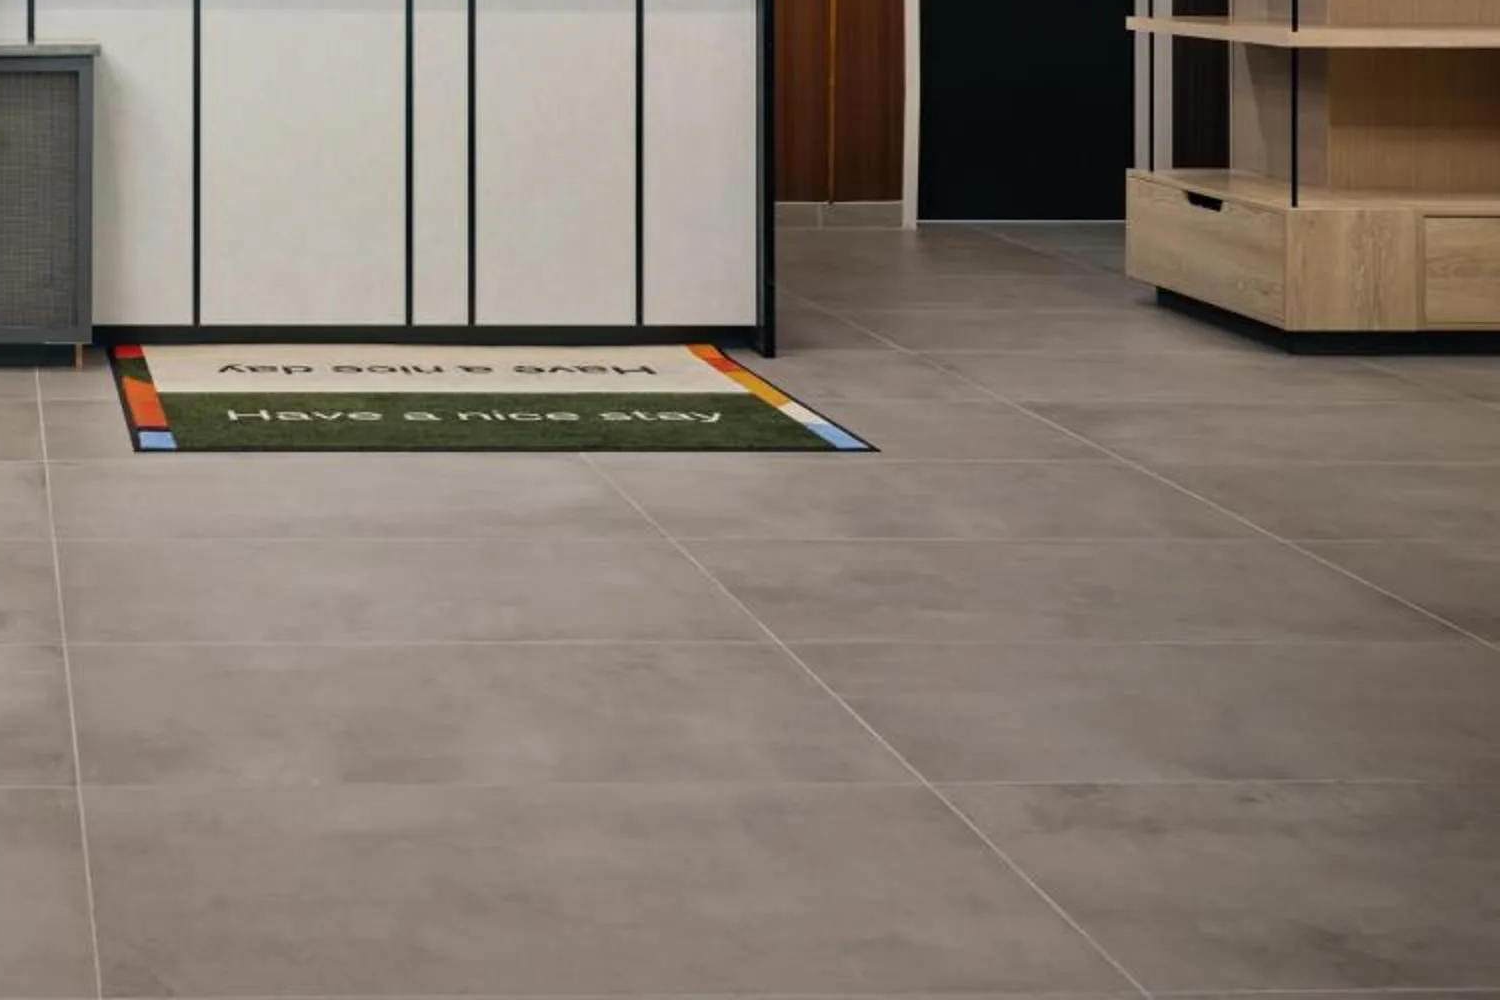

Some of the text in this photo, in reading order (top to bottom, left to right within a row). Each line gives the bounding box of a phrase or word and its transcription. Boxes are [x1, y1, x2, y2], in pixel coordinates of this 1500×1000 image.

[218, 363, 657, 375] Have a nice day
[227, 408, 722, 423] Have a nice stay
